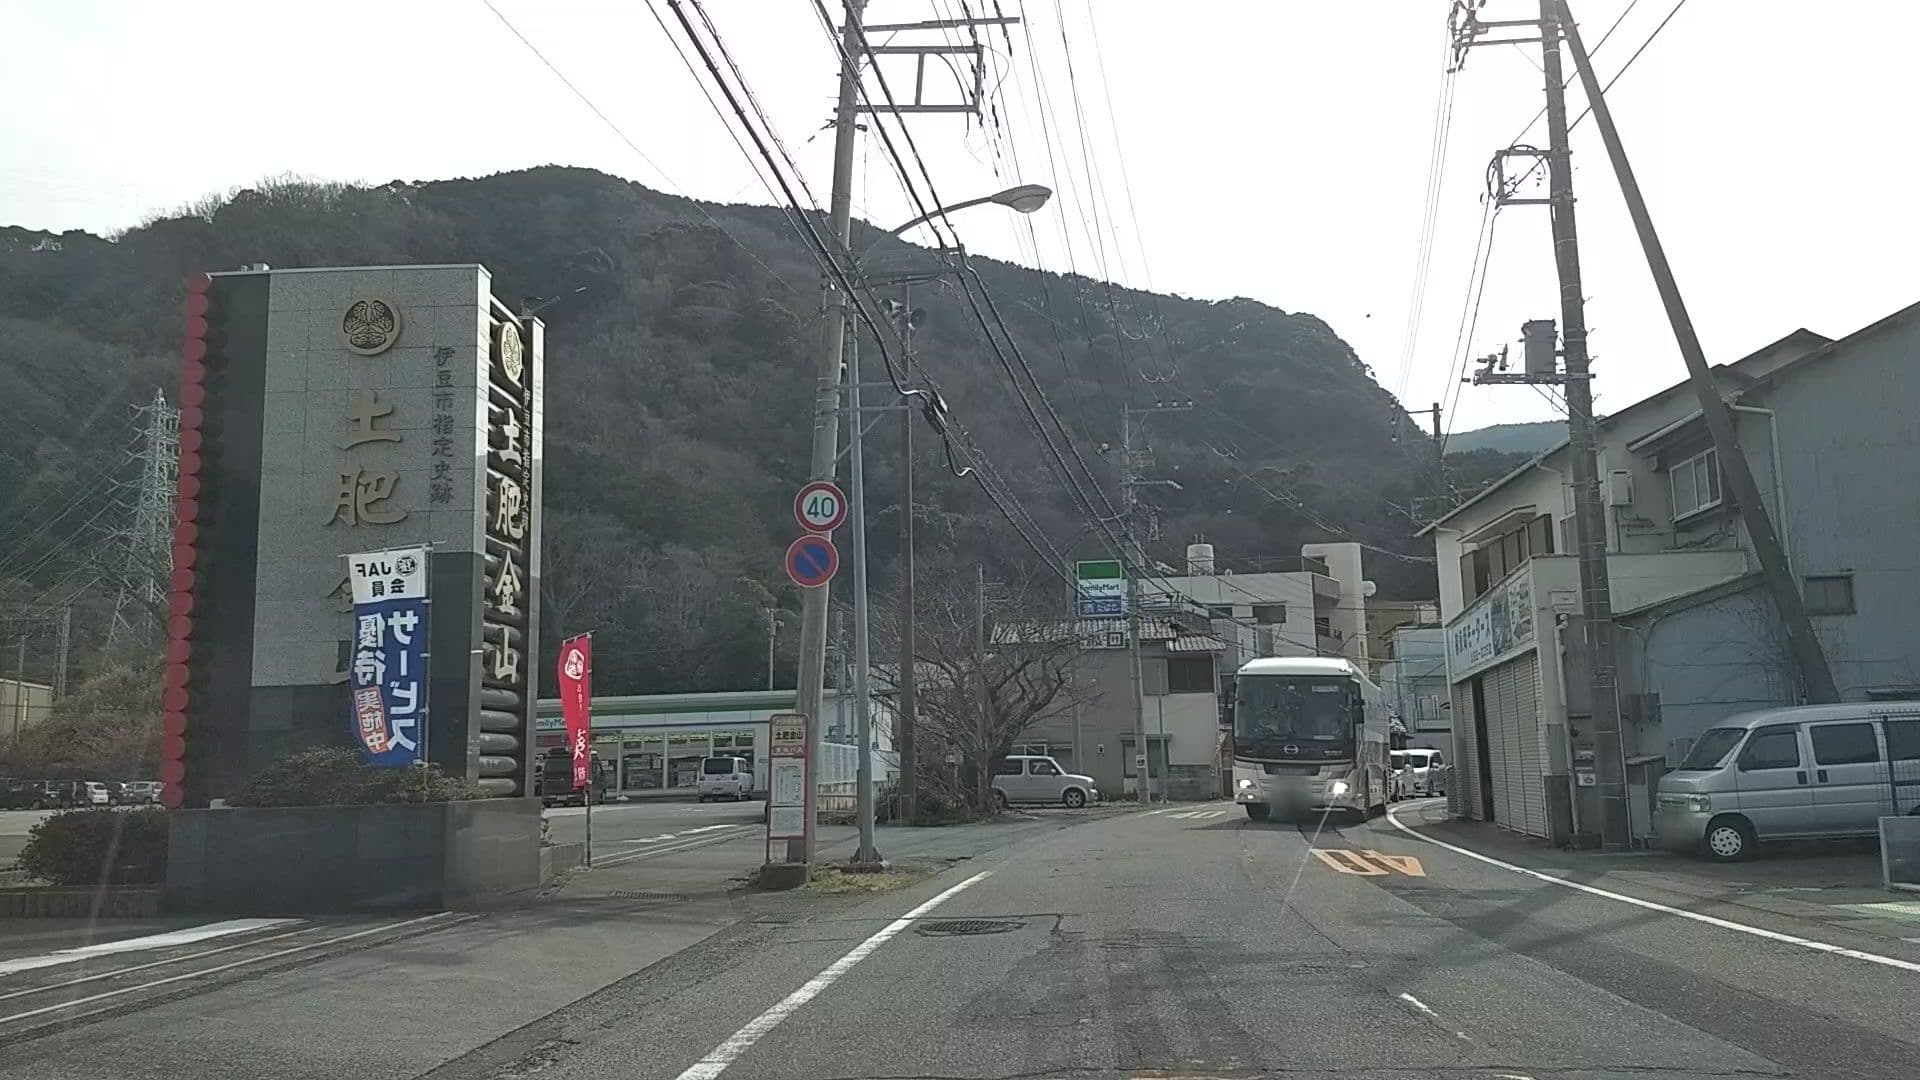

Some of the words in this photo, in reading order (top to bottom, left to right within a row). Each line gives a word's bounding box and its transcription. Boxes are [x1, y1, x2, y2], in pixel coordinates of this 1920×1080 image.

[433, 347, 455, 504] 伊豆市指定史跡
[494, 407, 525, 685] 土肥金山
[807, 497, 835, 518] 40
